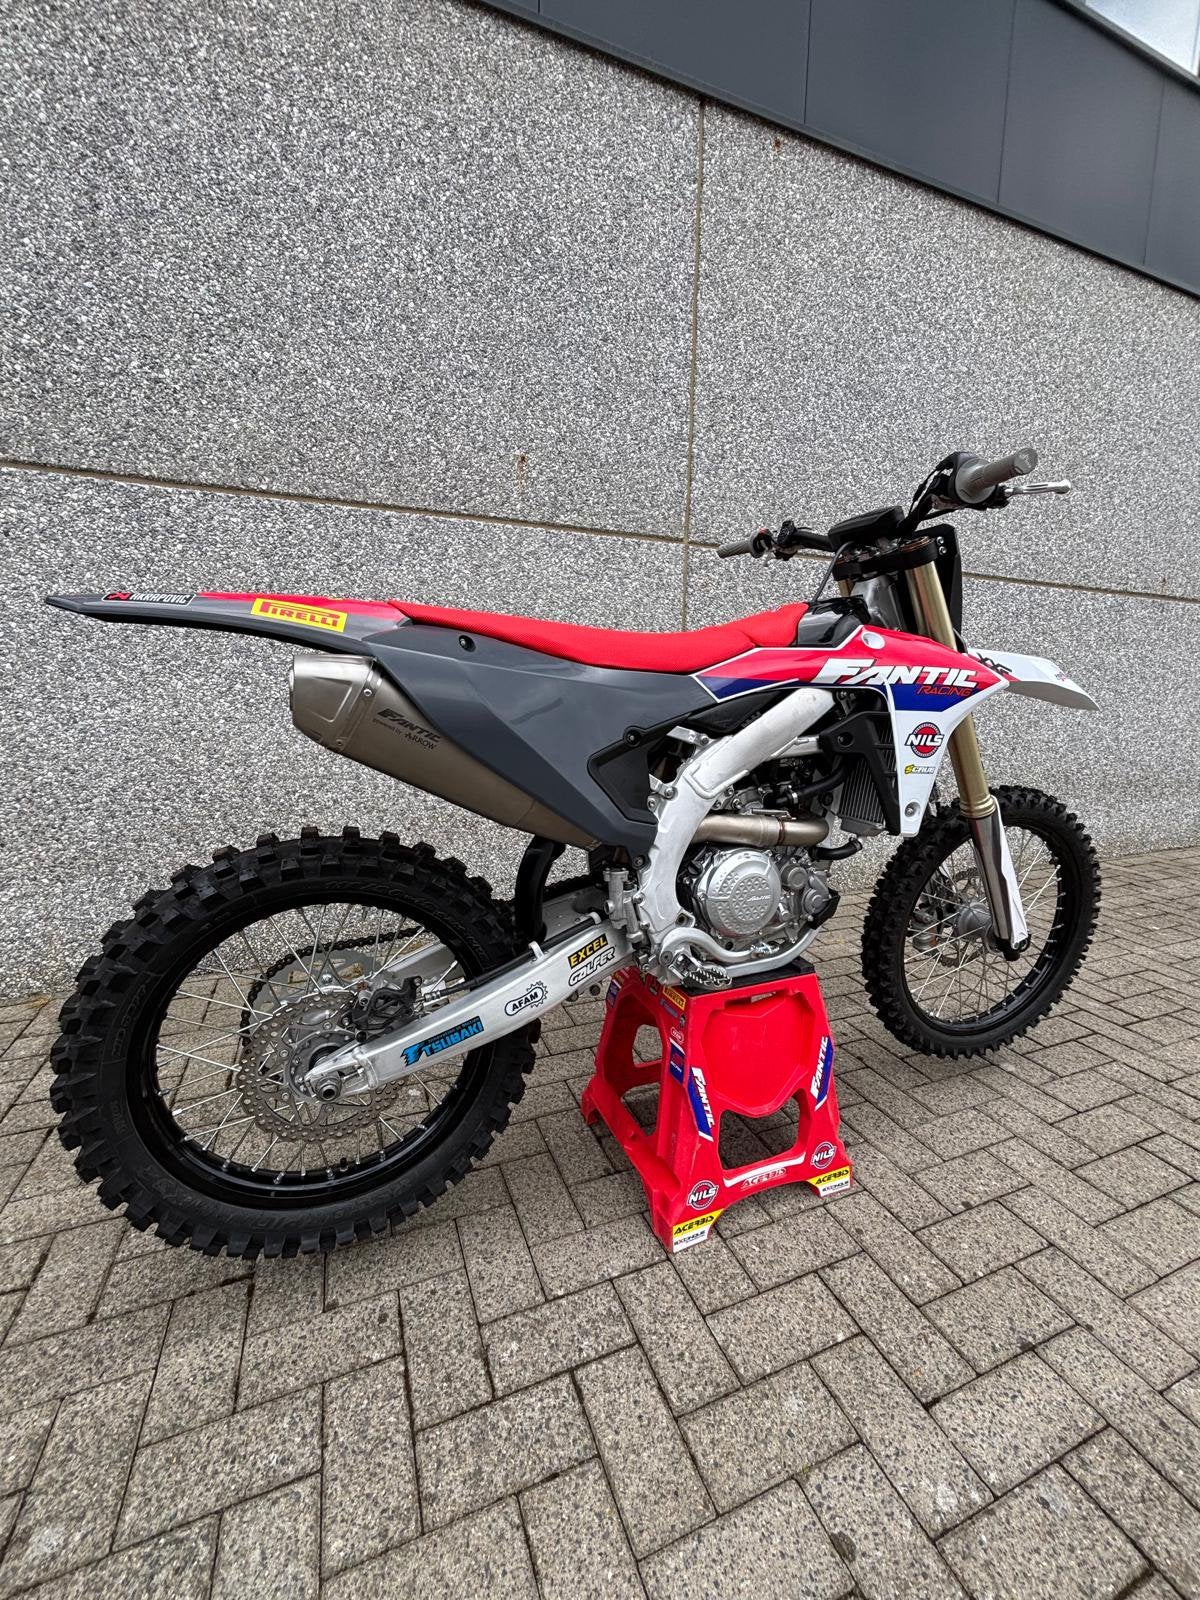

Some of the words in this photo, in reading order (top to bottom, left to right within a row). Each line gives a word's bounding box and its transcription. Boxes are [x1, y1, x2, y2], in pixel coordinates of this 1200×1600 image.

[259, 601, 341, 627] PIRELLI
[812, 658, 978, 688] FANTIC
[916, 685, 974, 697] RACING
[377, 708, 441, 743] FANTIC
[405, 732, 437, 750] ARROW
[905, 733, 945, 747] NILS
[570, 936, 607, 968] EXCEL
[569, 946, 615, 986] GALFER
[512, 991, 539, 1011] AFAM
[422, 1021, 483, 1057] TSUBAKI
[810, 1036, 828, 1099] FANTIC
[691, 1067, 715, 1128] FANTIC
[812, 1149, 835, 1163] NILS
[741, 1167, 787, 1188] ACERBIS
[815, 1169, 849, 1185] ACERBIS
[688, 1187, 717, 1204] NILS
[674, 1215, 715, 1236] ACERBIS
